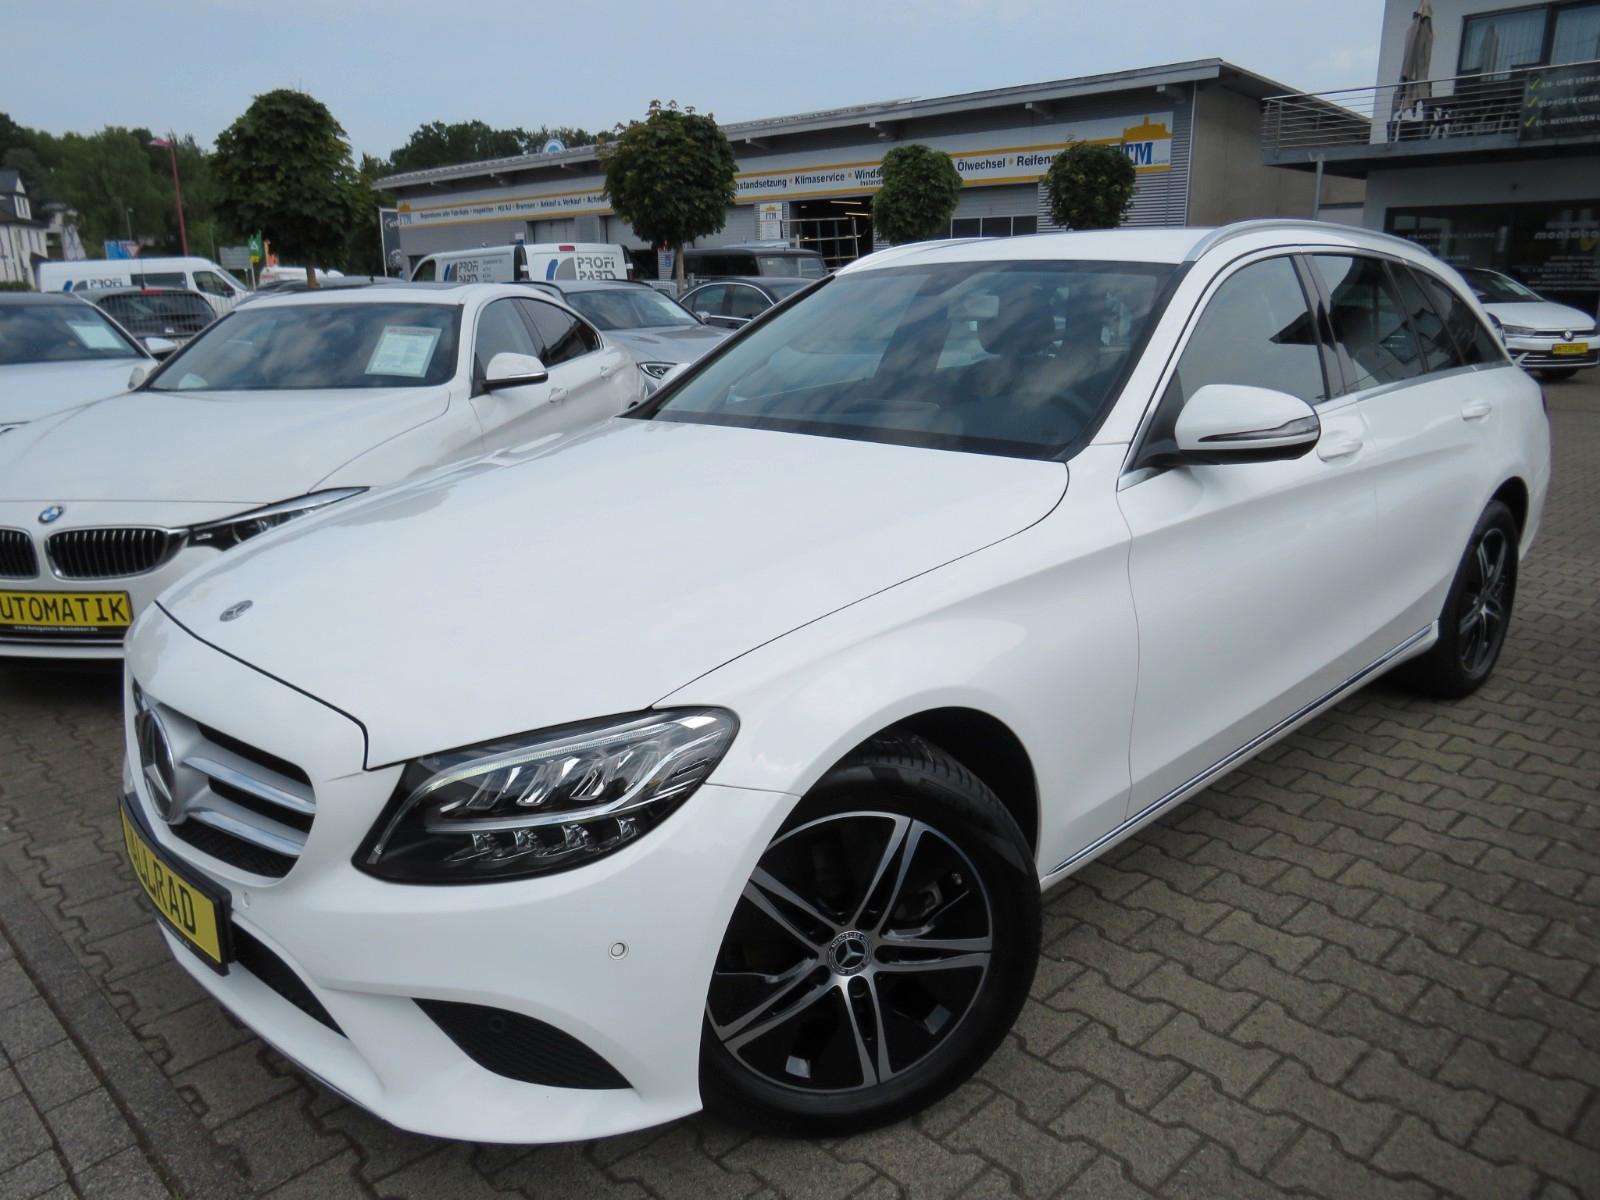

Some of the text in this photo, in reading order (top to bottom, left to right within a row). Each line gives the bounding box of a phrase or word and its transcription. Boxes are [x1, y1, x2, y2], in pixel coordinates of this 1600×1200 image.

[735, 178, 787, 192] nstandsetzung
[794, 172, 845, 186] Klimaservice
[854, 169, 881, 180] Winds
[957, 158, 1006, 172] Ölwechsel
[0, 595, 128, 622] UTOMATIK
